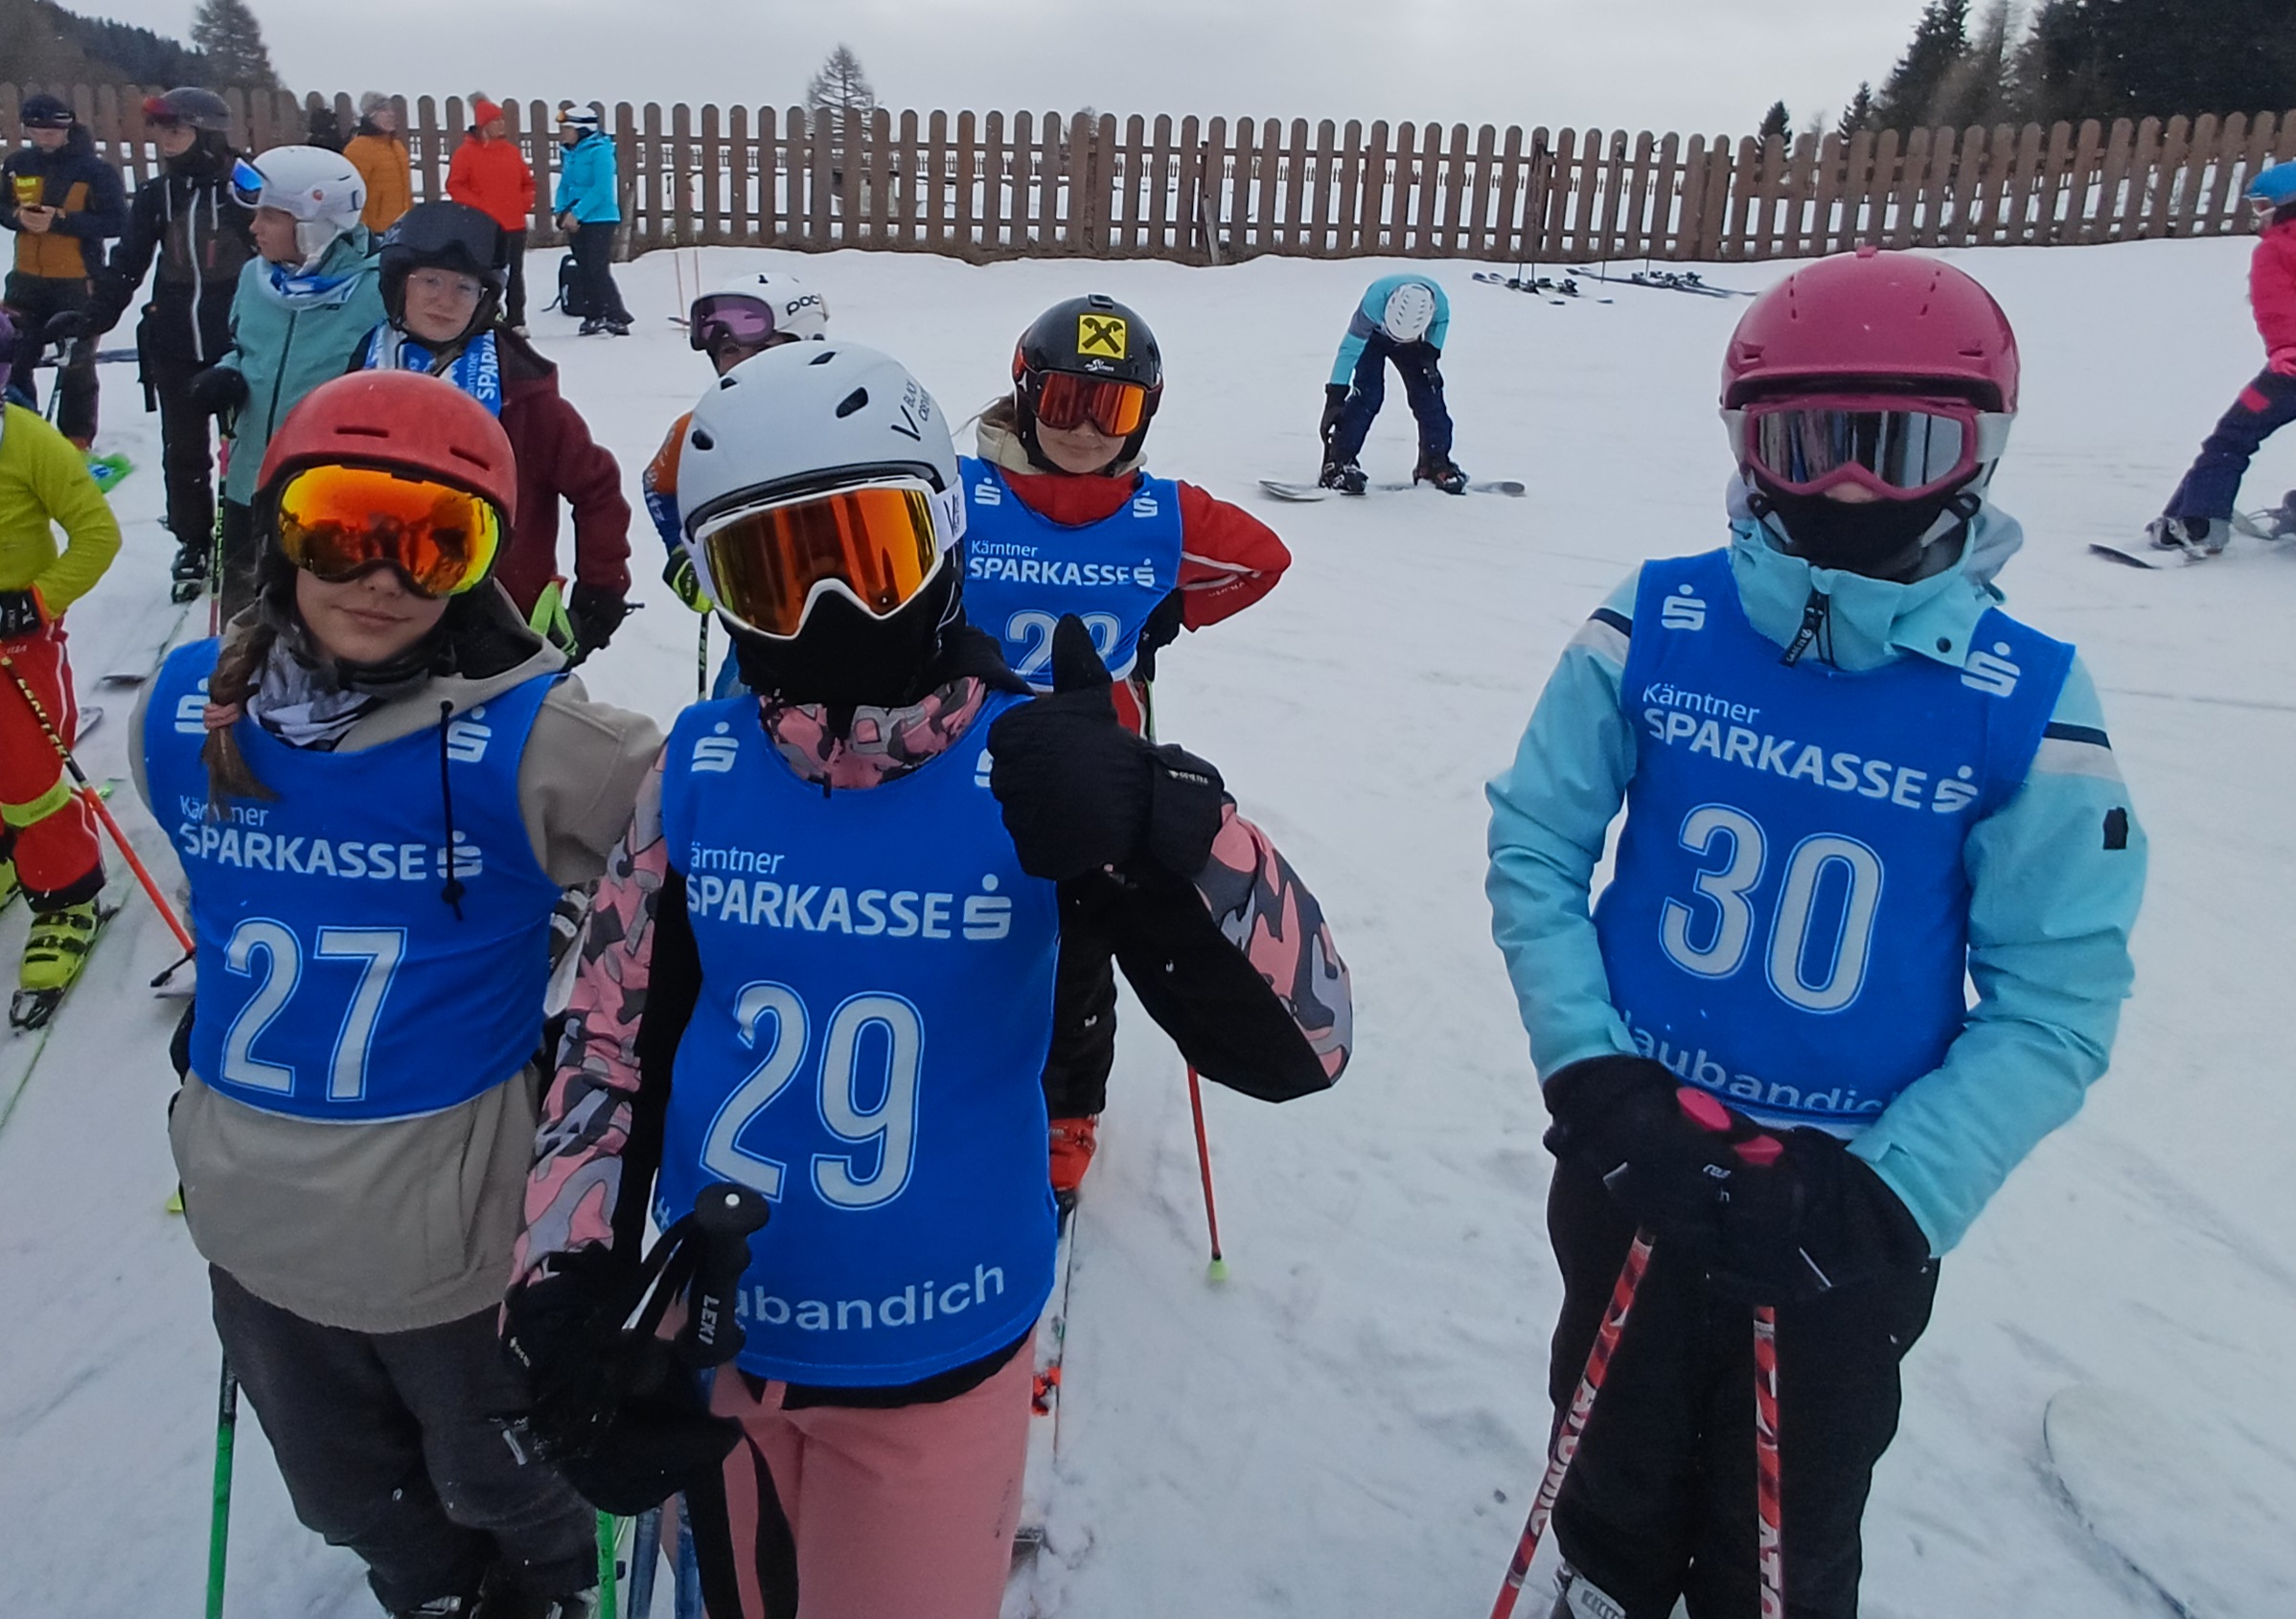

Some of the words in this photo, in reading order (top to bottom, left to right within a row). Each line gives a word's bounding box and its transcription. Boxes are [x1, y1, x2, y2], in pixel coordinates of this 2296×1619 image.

[969, 557, 1132, 586] SPARKASSE
[971, 540, 1039, 558] Kärntner
[1642, 681, 1761, 725] Kärntner
[1642, 706, 1928, 810] SPARKASSE
[179, 794, 269, 827] Kärner
[179, 822, 427, 880] SPARKASSE
[690, 841, 785, 875] ärntner
[686, 872, 953, 940] SPARKASSE
[1658, 802, 1886, 1015] 30
[219, 916, 408, 1103] 27
[700, 979, 925, 1211] 29
[698, 1293, 721, 1346] LEKI
